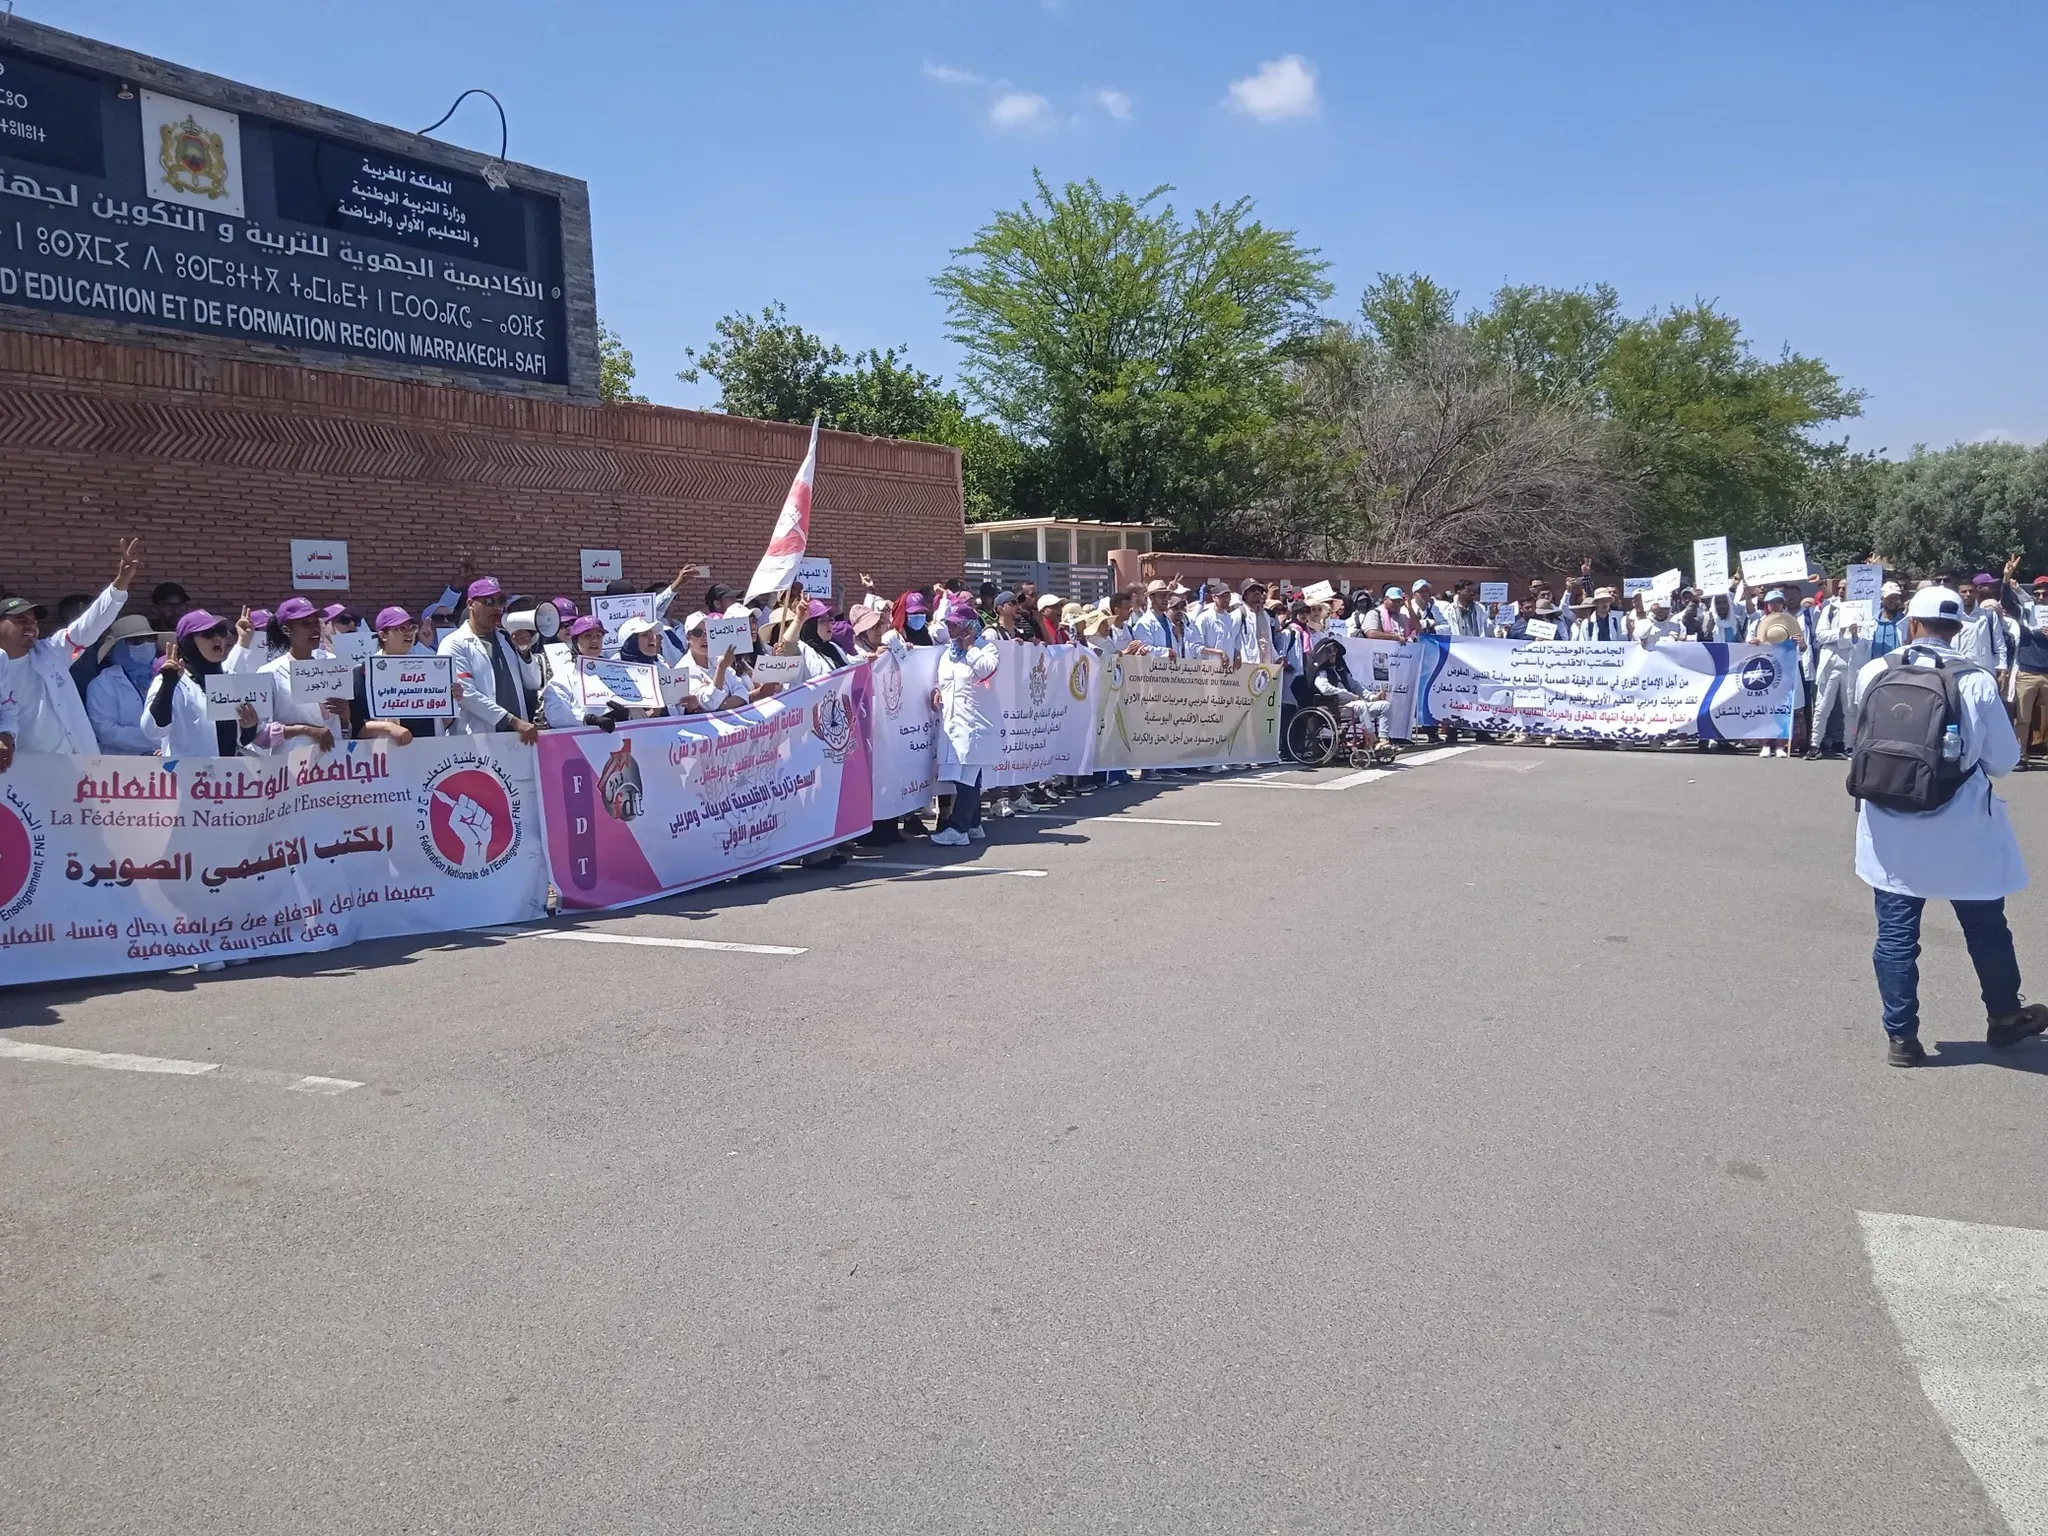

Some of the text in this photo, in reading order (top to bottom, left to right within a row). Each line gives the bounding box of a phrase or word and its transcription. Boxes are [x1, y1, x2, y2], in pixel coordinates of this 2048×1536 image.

[362, 158, 452, 195] المملكة المغربية
[351, 180, 466, 224] وزارة التربية الوطنية
[337, 199, 480, 248] و التعليم الأولي والرياضة
[92, 192, 544, 300] الأكاديمية الجهوية للتربية و التكوين
[1, 267, 156, 315] D'EDUCATION
[162, 293, 188, 320] ET
[194, 298, 222, 326] DE
[227, 303, 336, 343] FORMATION
[341, 324, 405, 354] REGION
[798, 568, 829, 579] لا للمهام
[609, 609, 629, 620] أساتذة
[709, 623, 747, 639] نعم للادماج
[1511, 646, 1624, 656] الجامعة الوطنية للتعليم
[295, 664, 348, 678] نطالب بالزيادة
[758, 660, 799, 671] نعم للادماج
[1149, 662, 1168, 673] للشغل
[1587, 659, 1624, 669] المكتب
[400, 673, 426, 683] كرامة
[674, 673, 687, 685] نعم
[1492, 670, 1511, 682] سياسة
[1513, 676, 1521, 686] مع
[1572, 674, 1594, 687] الوظيفة
[1610, 675, 1619, 691] في
[1680, 678, 1688, 688] من
[331, 678, 342, 690] في
[1455, 685, 1470, 693] تحت
[211, 691, 268, 706] لا للوساطة
[378, 686, 447, 697] أساتذة التعليم الأولي
[382, 698, 446, 709] فوق كل اعتبار
[1141, 694, 1162, 706] التعليم
[1211, 695, 1234, 708] الوطنية
[1613, 695, 1634, 708] التعليم
[1144, 711, 1172, 725] اليوسفية
[1574, 710, 1596, 722] الحقوق
[1715, 705, 1768, 719] المغربي للشغل
[781, 708, 804, 734] النقابة
[1200, 713, 1223, 726] المكتب
[1155, 733, 1170, 744] الحق
[1184, 736, 1192, 745] من
[74, 750, 389, 804] الجامعة الوطنية للتعليم
[453, 752, 519, 798] الجامعة الوطنية
[6, 784, 43, 831] الجامعة
[50, 788, 412, 828] La Fédération Nationale de l'Enseignement
[419, 834, 445, 872] Fédération
[444, 865, 479, 880] Nationale
[480, 867, 490, 878] de
[512, 799, 521, 819] FNE
[722, 813, 778, 856] التعليم الأولي
[34, 834, 45, 857] FNE
[65, 825, 393, 893] المكتب الإقليمي الصويرة
[356, 887, 379, 907] من
[385, 884, 435, 902] جميعا
[274, 899, 324, 927] الدفاع
[126, 916, 167, 937] رجال
[173, 915, 233, 936] كرامة
[240, 912, 267, 931] عن
[0, 922, 55, 948] التعلي
[127, 922, 338, 960] وعن المدرسة العمومية
